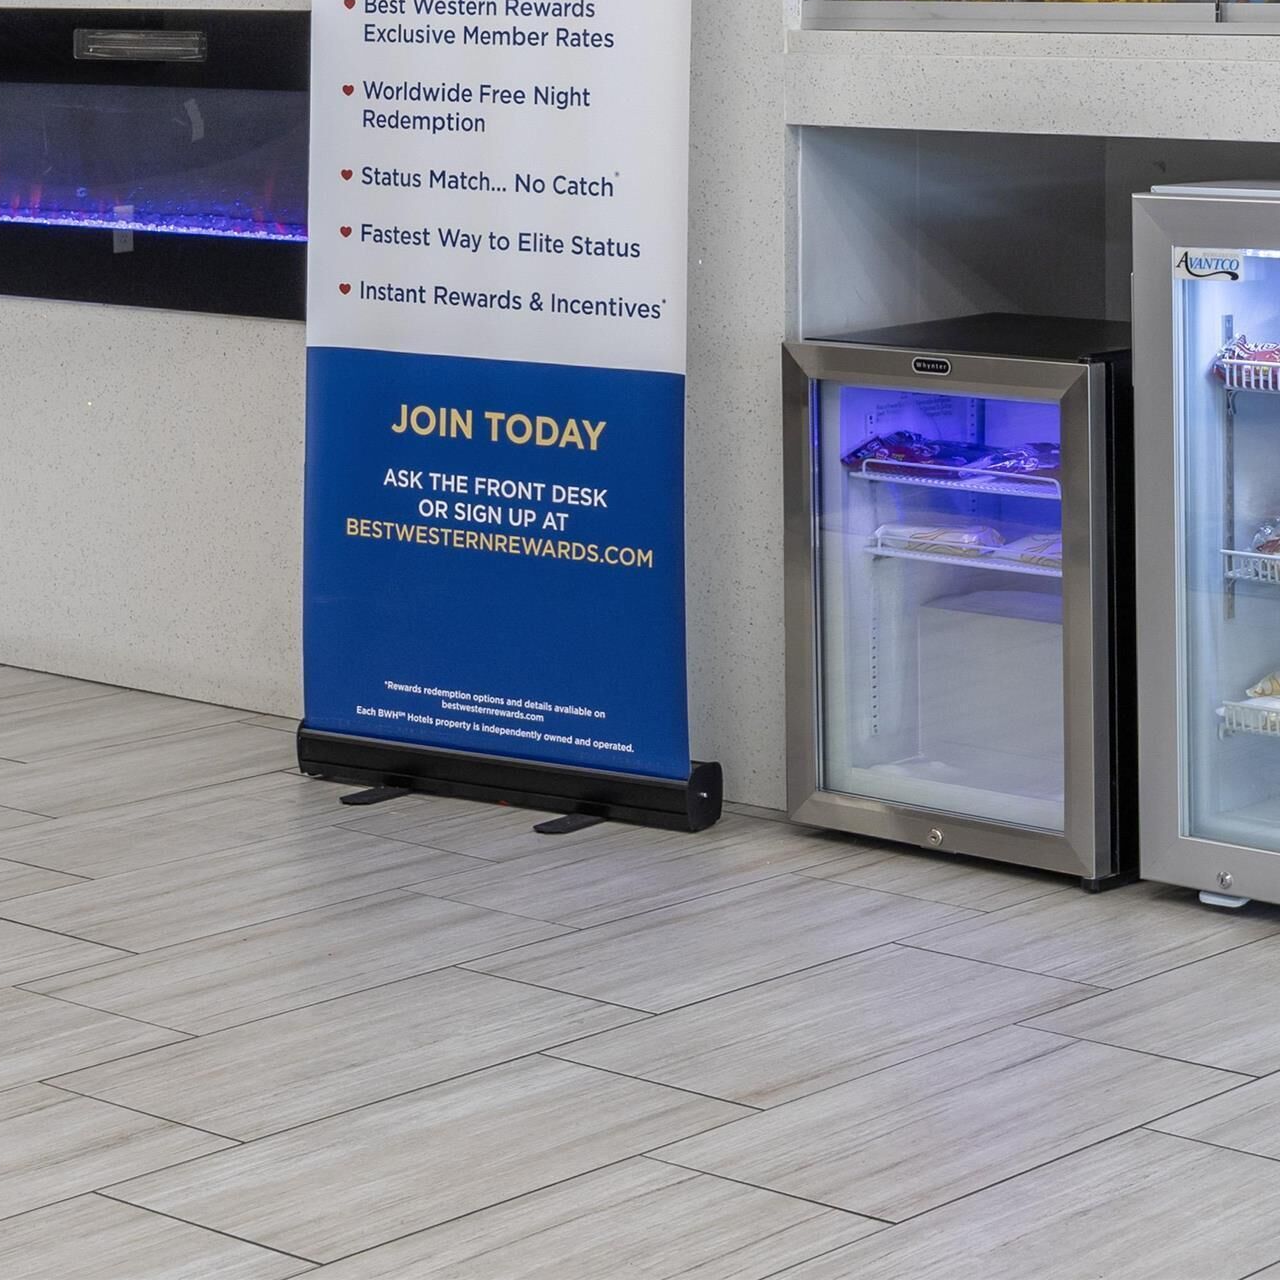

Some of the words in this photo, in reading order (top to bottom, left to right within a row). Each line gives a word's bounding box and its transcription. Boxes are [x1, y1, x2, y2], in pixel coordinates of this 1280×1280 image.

[364, 24, 456, 44] Exclusive
[463, 26, 549, 47] Member
[556, 28, 615, 48] Rates
[363, 81, 473, 103] Worldwide
[479, 84, 526, 105] Free
[534, 86, 591, 109] Night
[363, 110, 486, 134] Redemption
[361, 166, 422, 188] Status
[429, 169, 507, 193] Match...
[515, 174, 545, 194] No
[361, 224, 430, 246] Fastest
[438, 227, 482, 253] Way
[489, 231, 510, 251] to
[518, 232, 565, 254] Elite
[571, 236, 641, 258] Status
[360, 281, 426, 304] Instant
[434, 286, 522, 310] Rewards
[530, 293, 544, 312] &
[392, 404, 472, 439] JOIN
[485, 411, 607, 451] TODAY
[383, 468, 423, 490] ASK
[429, 472, 468, 494] THE
[474, 477, 546, 500] FRONT
[552, 484, 609, 508] DESK
[418, 499, 448, 519] OR
[454, 502, 502, 526] SIGN
[509, 507, 536, 528] UP
[542, 511, 569, 532] AT
[346, 518, 654, 568] BESTWESTERNREWARDS.COM
[423, 686, 471, 701] redemption
[473, 694, 505, 706] options
[506, 697, 522, 708] and
[524, 699, 553, 712] details
[594, 710, 606, 719] on
[441, 700, 545, 722] bestwesternrewards.com
[356, 705, 376, 717] Each
[407, 712, 434, 726] Hotels
[435, 717, 472, 732] property
[473, 722, 480, 732] is
[481, 723, 542, 742] independently
[543, 732, 573, 744] owned
[575, 736, 591, 747] and
[593, 739, 635, 754] operated.
